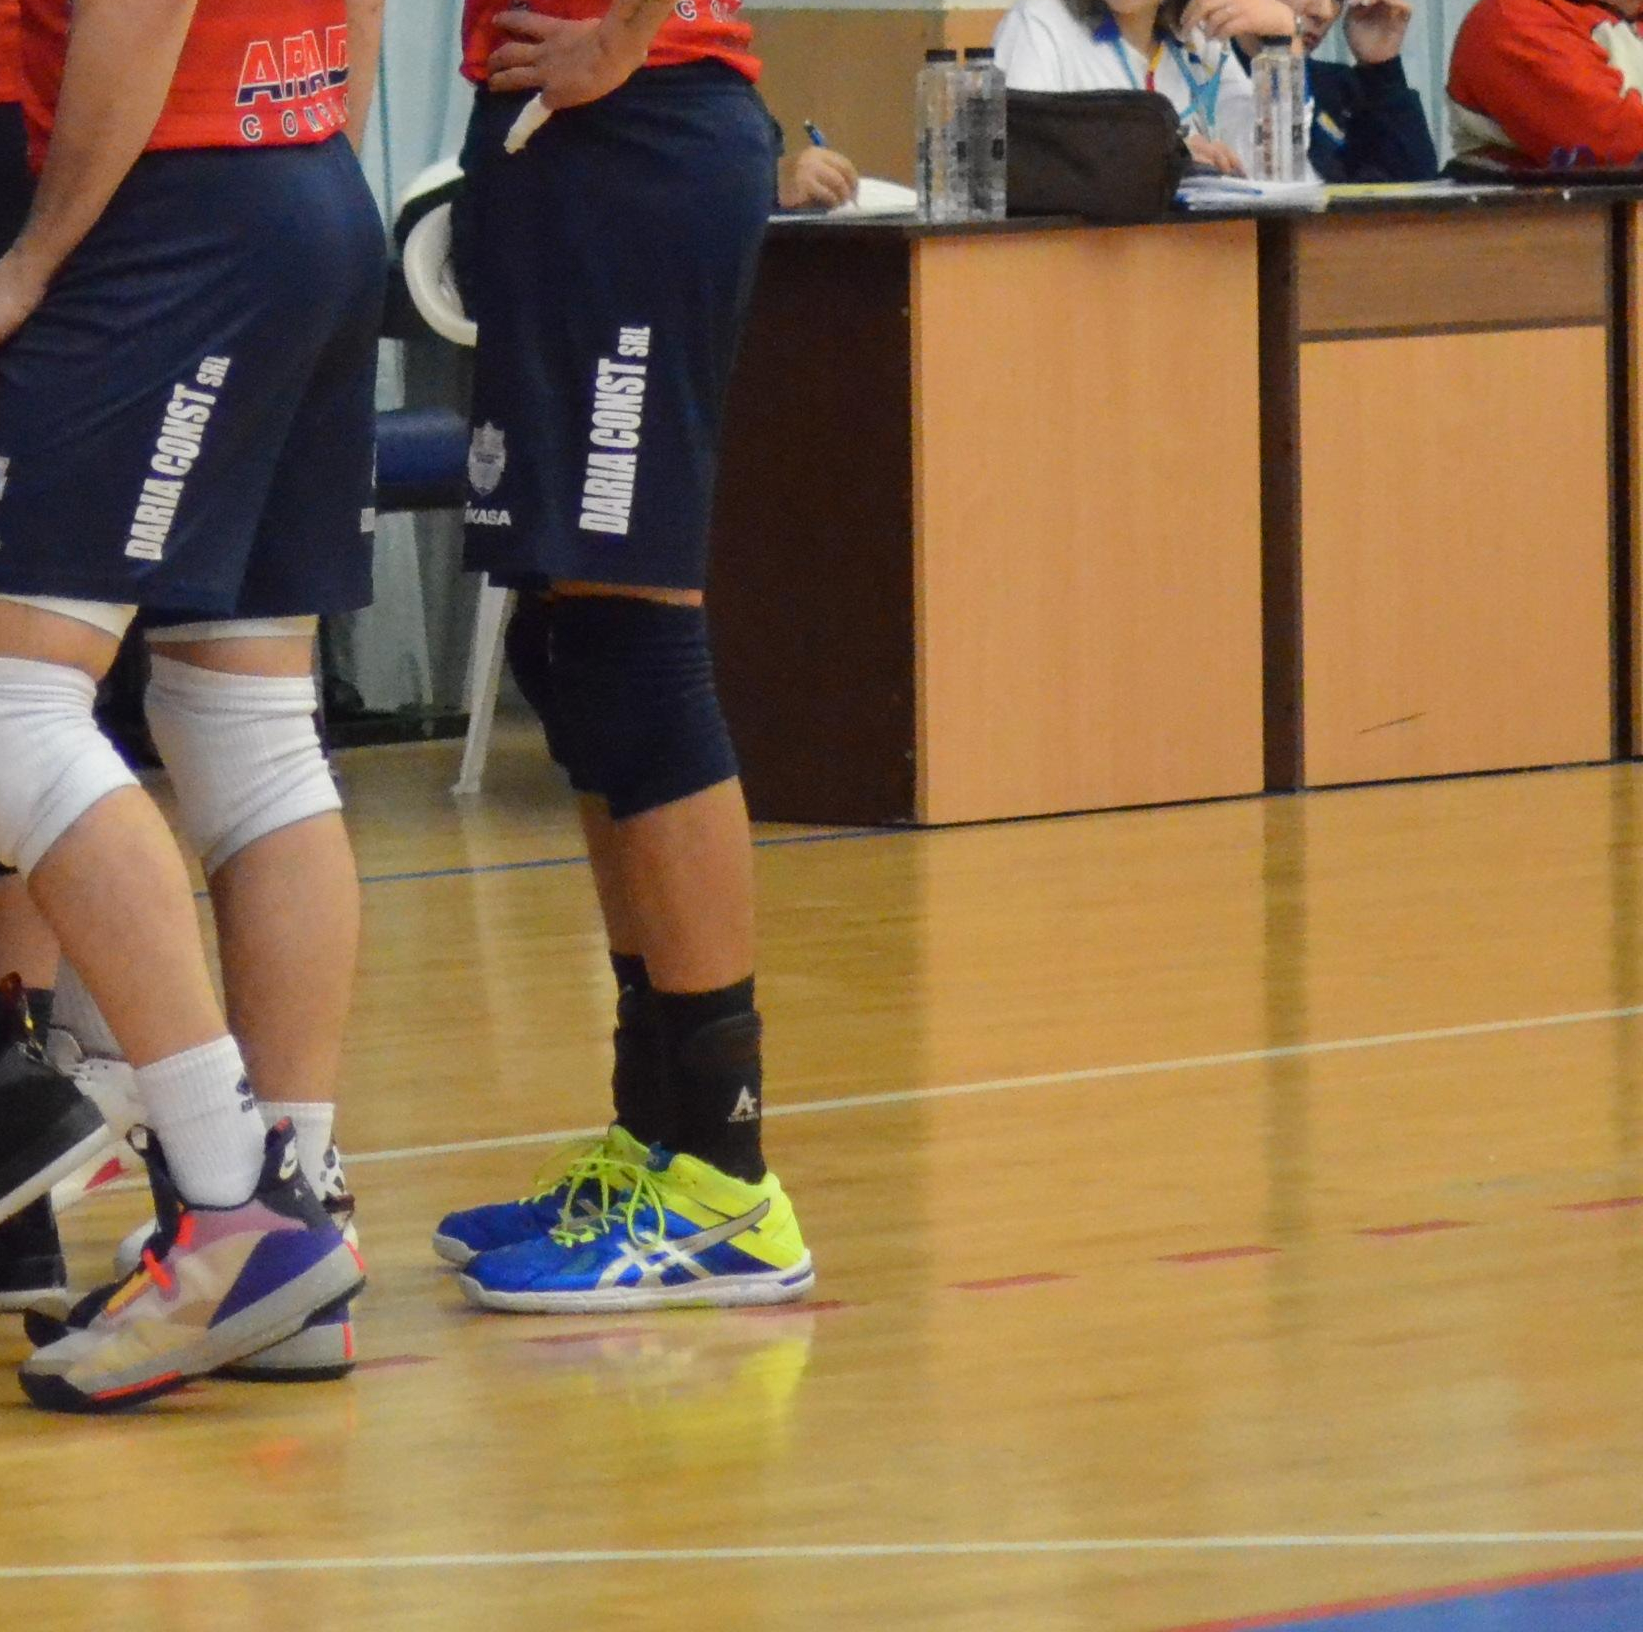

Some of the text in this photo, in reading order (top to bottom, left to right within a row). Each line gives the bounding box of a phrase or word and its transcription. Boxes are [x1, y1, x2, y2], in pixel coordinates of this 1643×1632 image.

[124, 354, 232, 562] DARIA CONST SRL
[579, 325, 652, 537] DARIA CONST SRL
